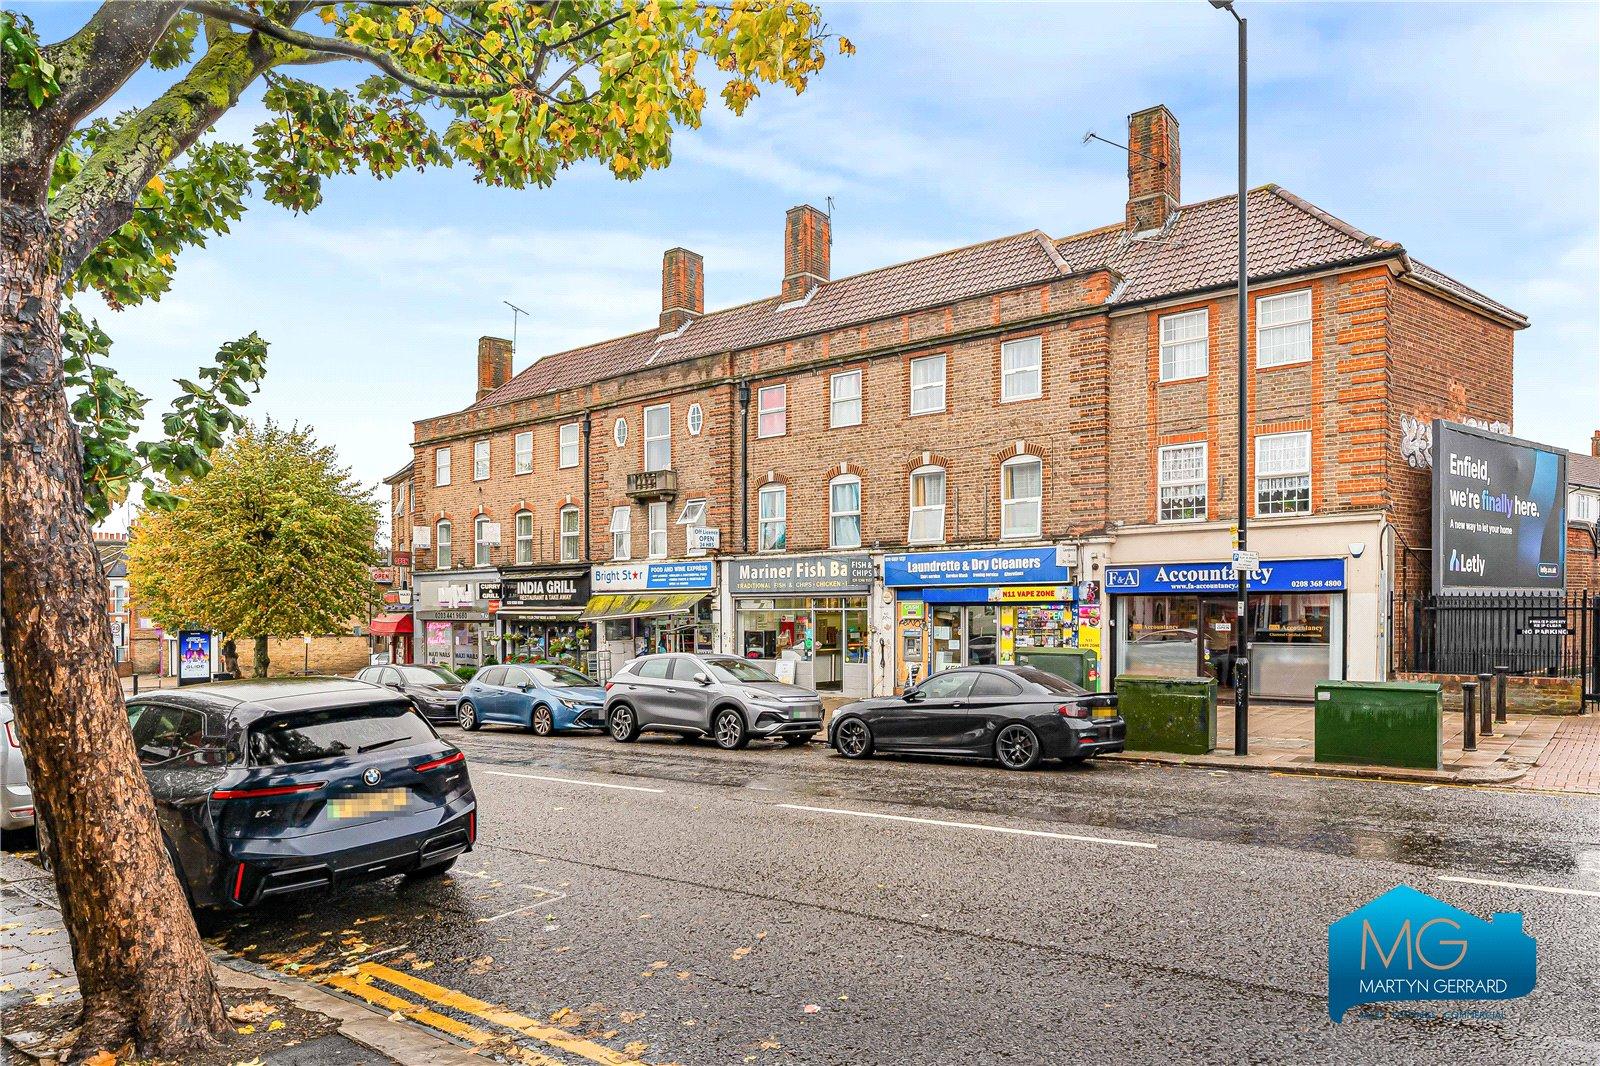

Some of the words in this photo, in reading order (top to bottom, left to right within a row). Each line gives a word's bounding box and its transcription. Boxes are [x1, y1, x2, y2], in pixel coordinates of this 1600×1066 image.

[1450, 453, 1491, 485] Enfield,
[1449, 488, 1480, 509] we're
[1481, 489, 1513, 518] finally
[1514, 495, 1540, 517] here.
[1449, 518, 1454, 528] A
[1455, 521, 1466, 530] new
[1466, 523, 1476, 533] way
[1476, 523, 1481, 532] to
[1489, 525, 1500, 534] your
[1500, 525, 1512, 534] home
[740, 564, 792, 580] Mariner
[796, 562, 826, 578] Fish
[908, 560, 960, 573] Laundrette
[962, 560, 970, 571] &
[972, 558, 990, 570] Dry
[991, 558, 1041, 570] Cleaners
[1460, 554, 1486, 576] Letly
[595, 570, 620, 584] Bright
[1108, 572, 1136, 586] F&A
[517, 581, 544, 594] INDIA
[546, 580, 576, 594] GRILL
[1282, 624, 1324, 632] Accountancy
